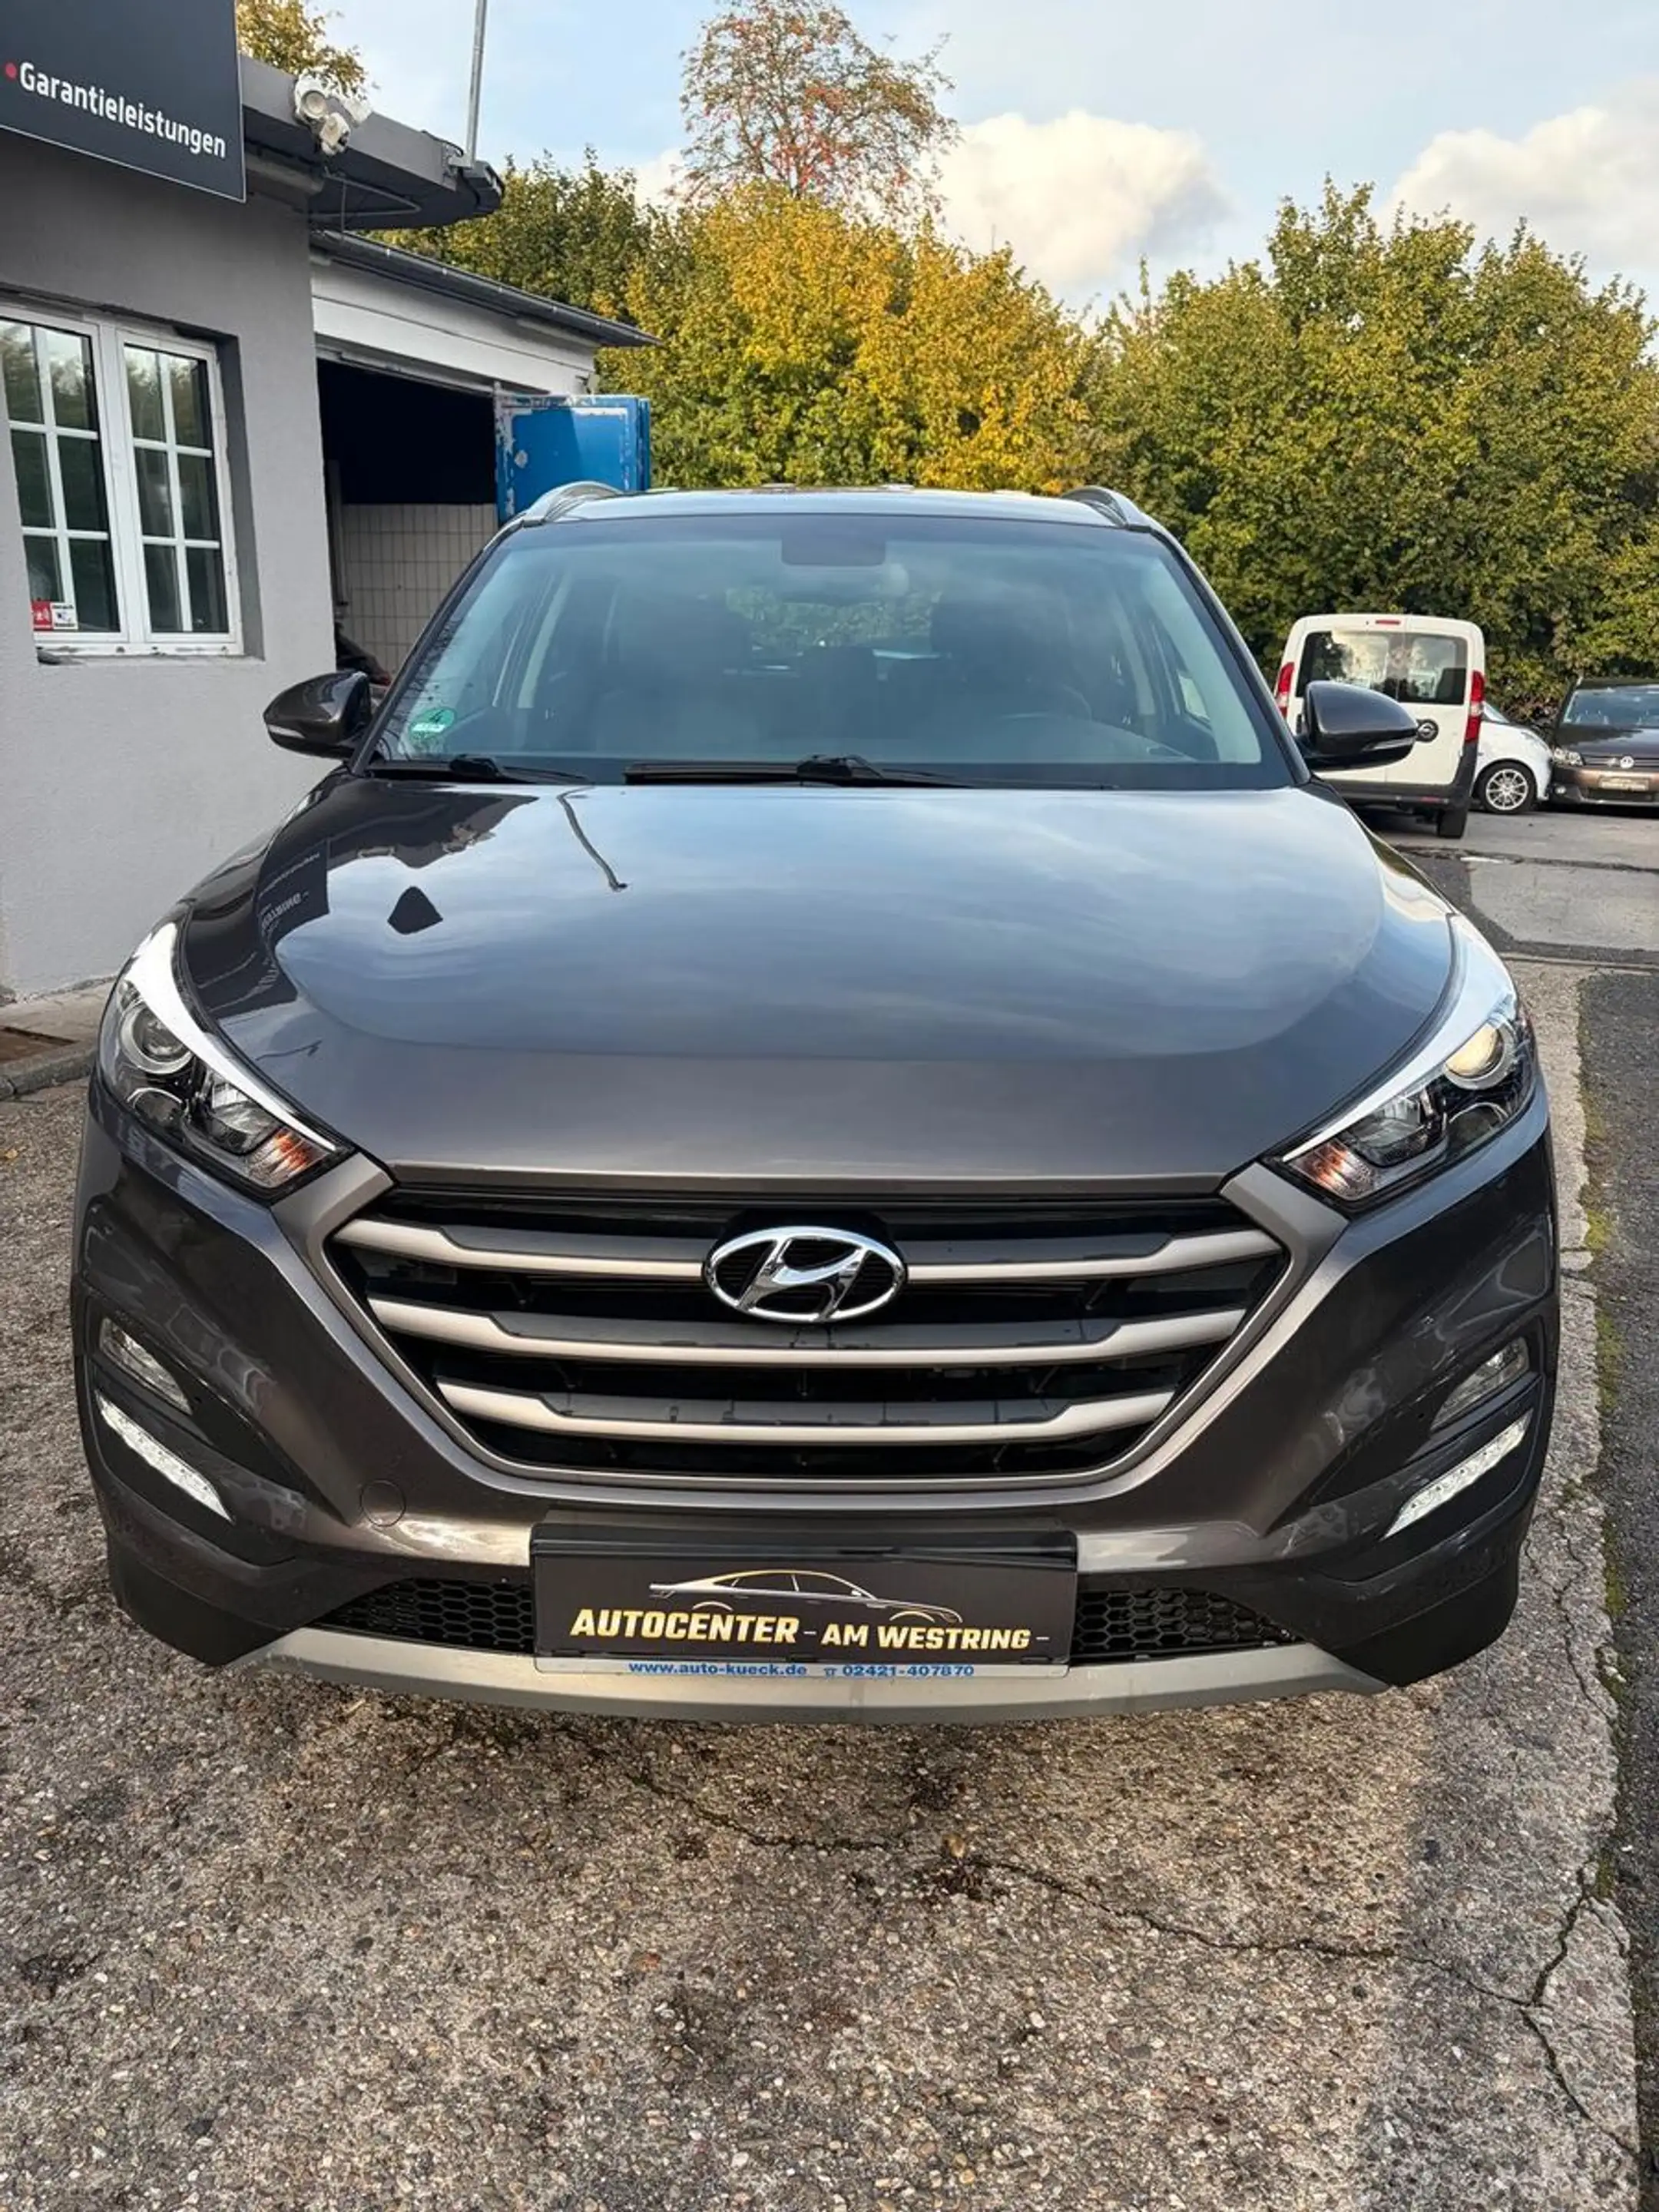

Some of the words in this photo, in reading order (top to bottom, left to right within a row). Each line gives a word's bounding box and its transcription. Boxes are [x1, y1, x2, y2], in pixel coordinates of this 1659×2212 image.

[19, 61, 226, 158] Garantieleistungen
[570, 1608, 800, 1644] AUTOCENTER
[820, 1623, 869, 1647] AM
[877, 1625, 1032, 1650] WESTRING
[628, 1661, 807, 1676] www.auto-kueck.de
[843, 1664, 974, 1677] 02421-407870
